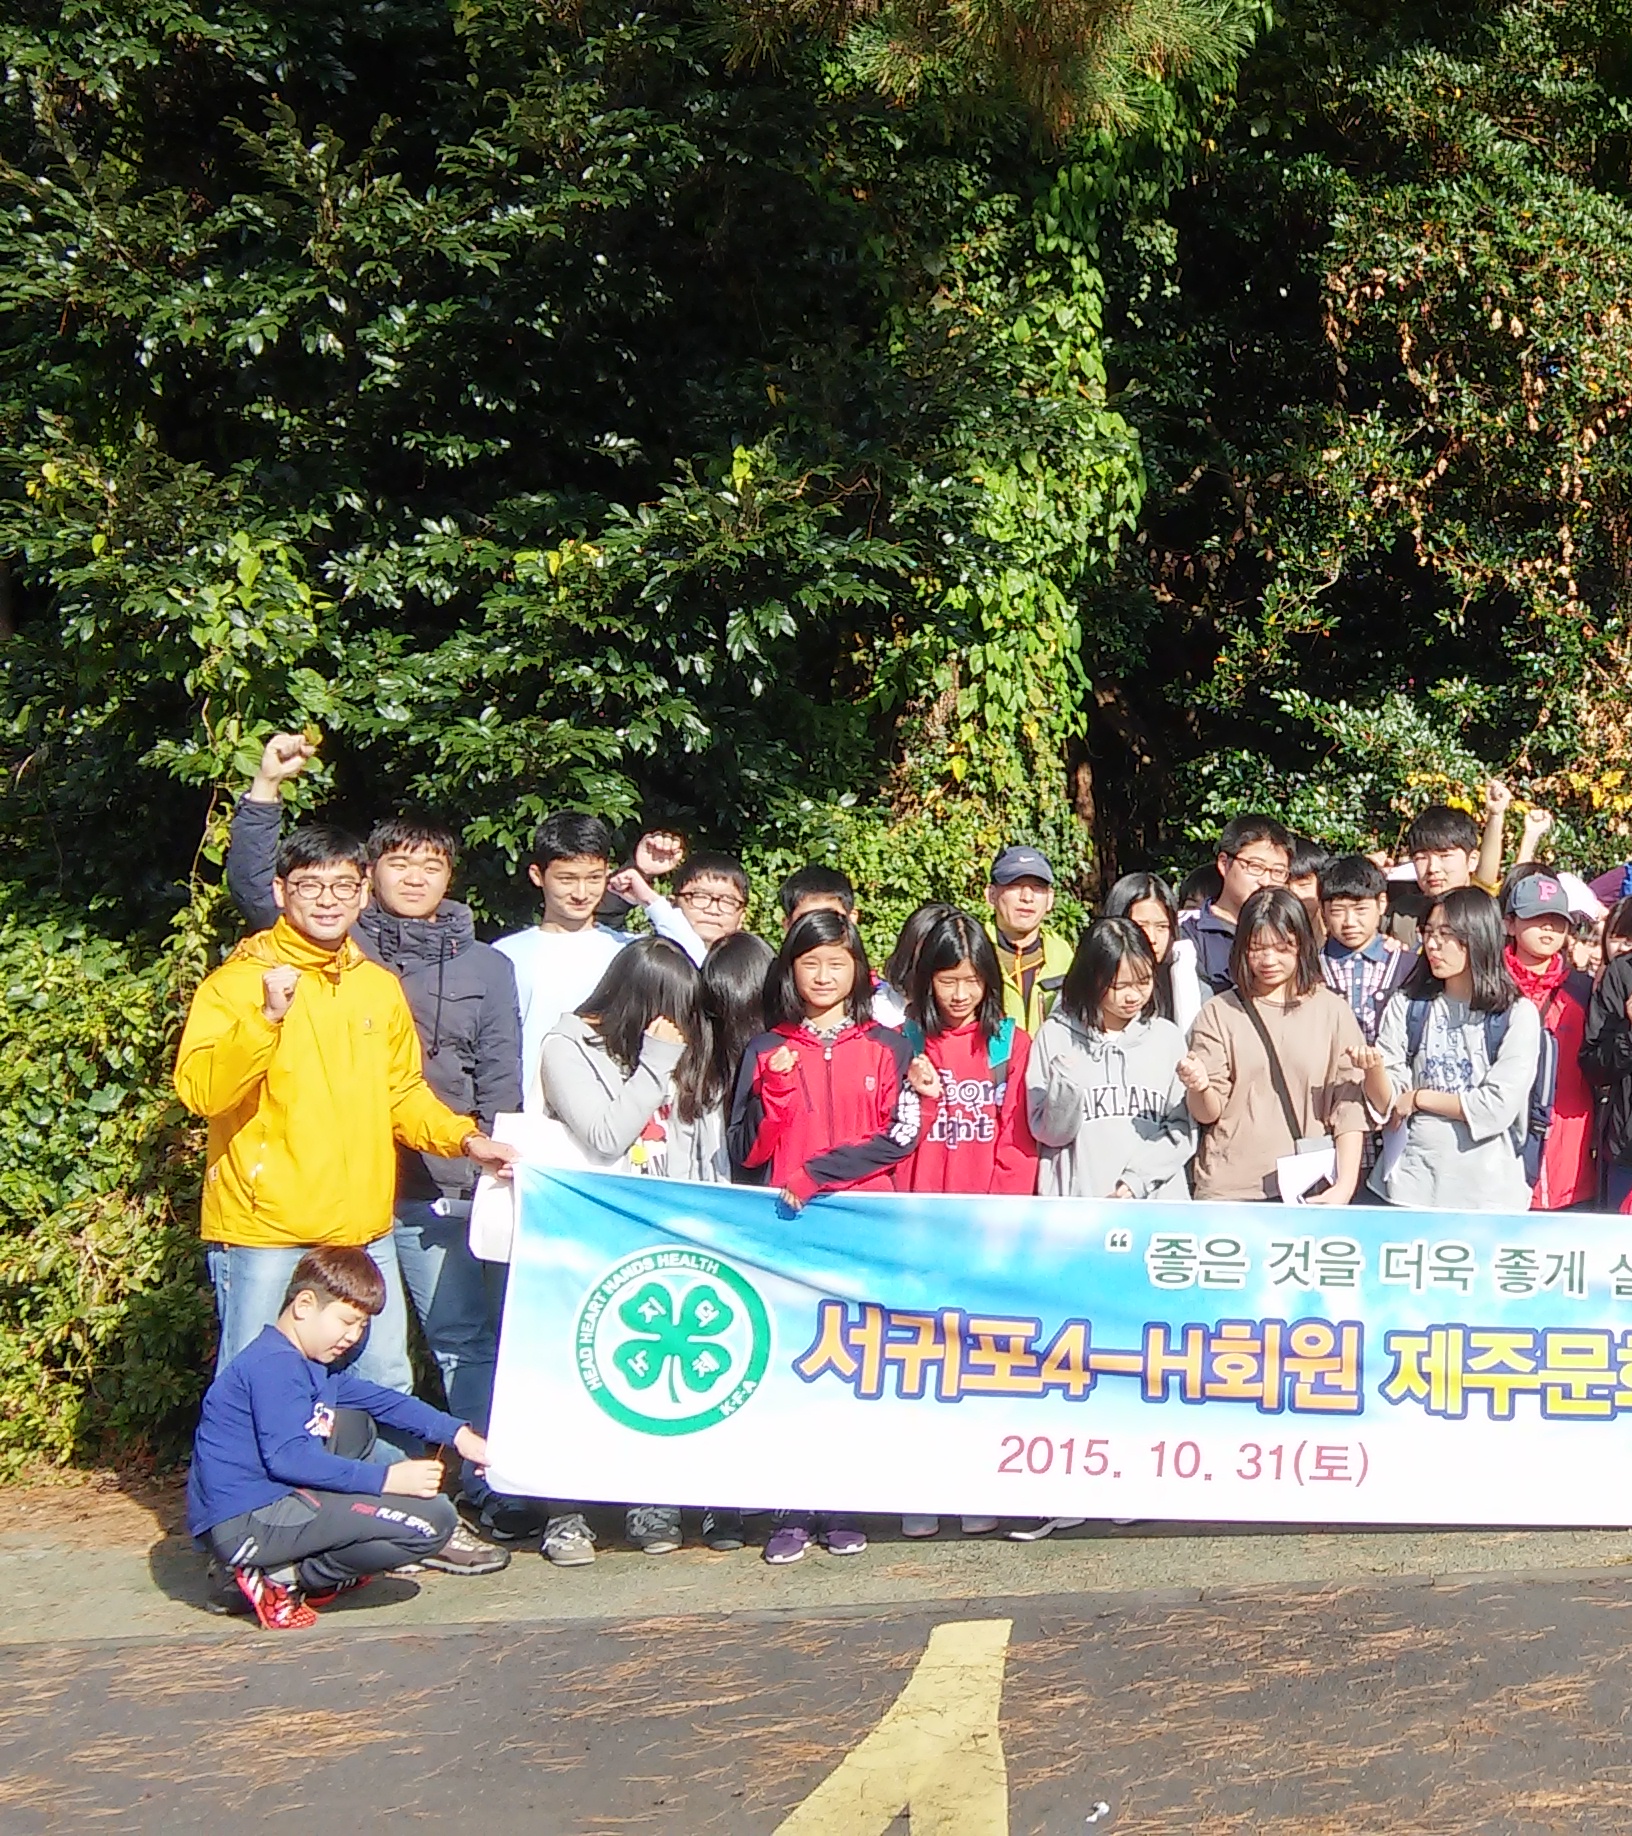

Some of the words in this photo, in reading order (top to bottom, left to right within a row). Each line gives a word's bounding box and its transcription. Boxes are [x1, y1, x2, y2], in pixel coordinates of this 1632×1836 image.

[1538, 880, 1558, 901] P
[1082, 1086, 1167, 1122] AKLAN
[601, 1256, 656, 1296] HANDS
[656, 1252, 721, 1275] HEALTH
[1149, 1236, 1246, 1286] 좋은
[1267, 1240, 1362, 1289] 것을
[1383, 1243, 1475, 1292] 더욱
[1494, 1247, 1587, 1295] 좋게
[579, 1292, 607, 1342] HEART
[636, 1296, 668, 1324] 지
[578, 1347, 604, 1391] HEAD
[625, 1349, 650, 1378] 노
[690, 1350, 721, 1379] 체
[996, 1434, 1123, 1479] 2015.
[1149, 1440, 1212, 1481] 10.
[1236, 1441, 1369, 1487] 31(토)
